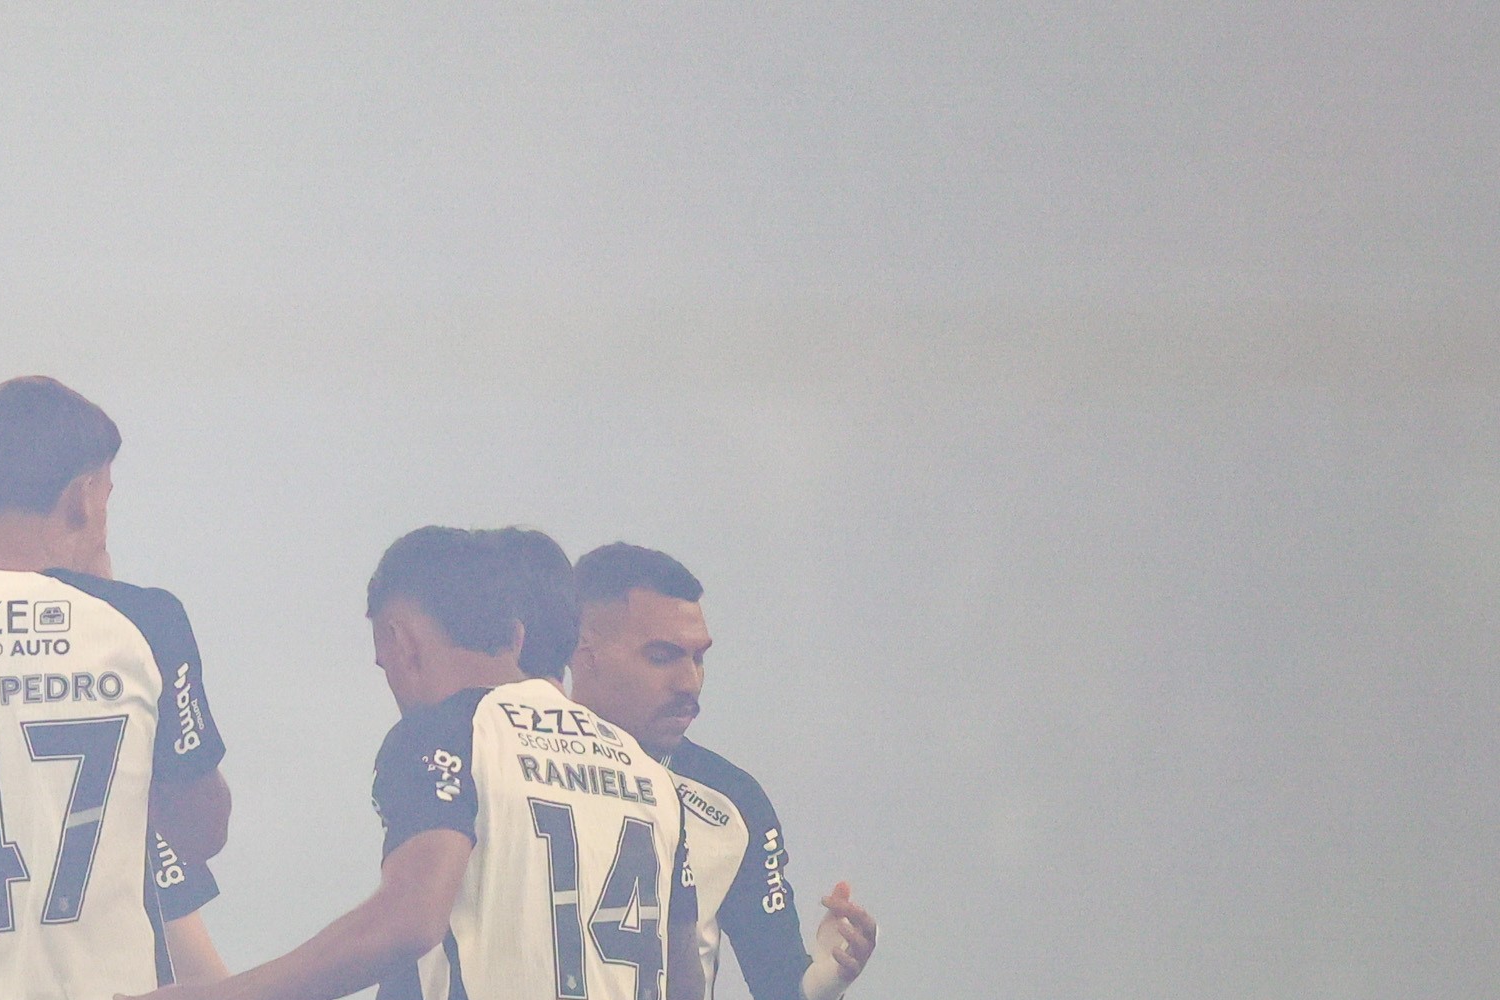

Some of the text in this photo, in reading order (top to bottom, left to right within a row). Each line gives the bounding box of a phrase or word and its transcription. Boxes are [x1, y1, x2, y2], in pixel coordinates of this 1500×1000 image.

[10, 639, 71, 657] AUTO
[0, 671, 124, 706] PEDRO
[174, 682, 201, 755] bmg
[498, 702, 597, 738] EZZE
[518, 732, 632, 766] SEGURO AUTO
[517, 753, 658, 807] RANIELE
[676, 783, 730, 826] Frimesa
